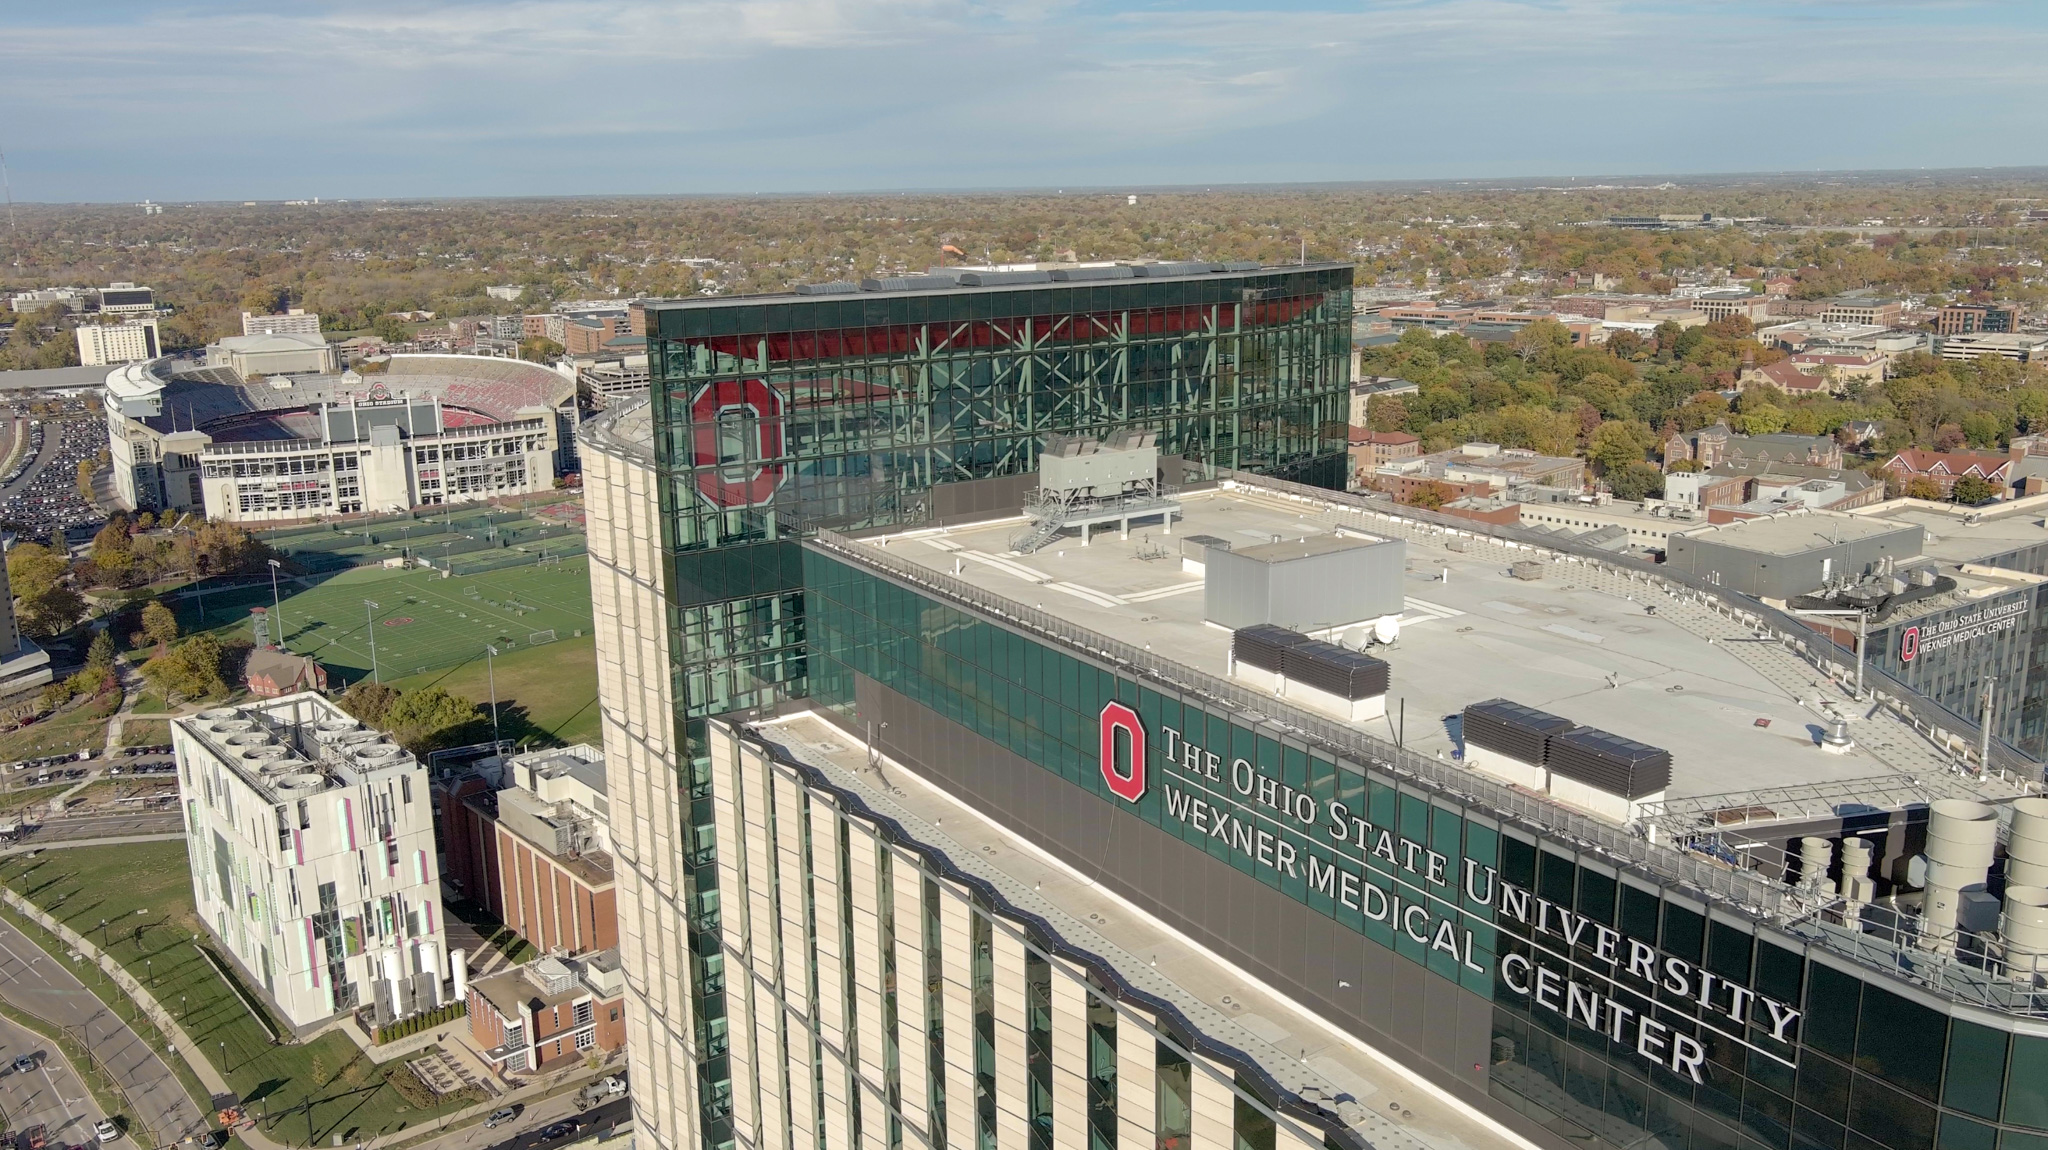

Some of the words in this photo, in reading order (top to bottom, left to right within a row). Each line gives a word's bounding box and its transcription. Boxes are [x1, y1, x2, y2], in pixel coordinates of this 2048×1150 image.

[1901, 626, 1919, 662] O
[1920, 636, 1952, 654] WEXNER
[1953, 626, 1985, 644] MEDICAL
[1987, 617, 2016, 634] CENTER
[1921, 625, 1937, 638] THE
[1938, 620, 1959, 633] OHIO
[1959, 612, 1982, 627] STATE
[1984, 600, 2028, 619] UNIVERSITY
[1100, 699, 1149, 804] O
[1162, 725, 1222, 783] THE
[1232, 758, 1317, 825] OHIO
[1328, 801, 1448, 887] STATE
[1463, 857, 1801, 1044] UNIVERSITY
[1164, 784, 1298, 879] WEXNER
[1308, 854, 1485, 974] MEDICAL
[1501, 953, 1705, 1085] CENTER
